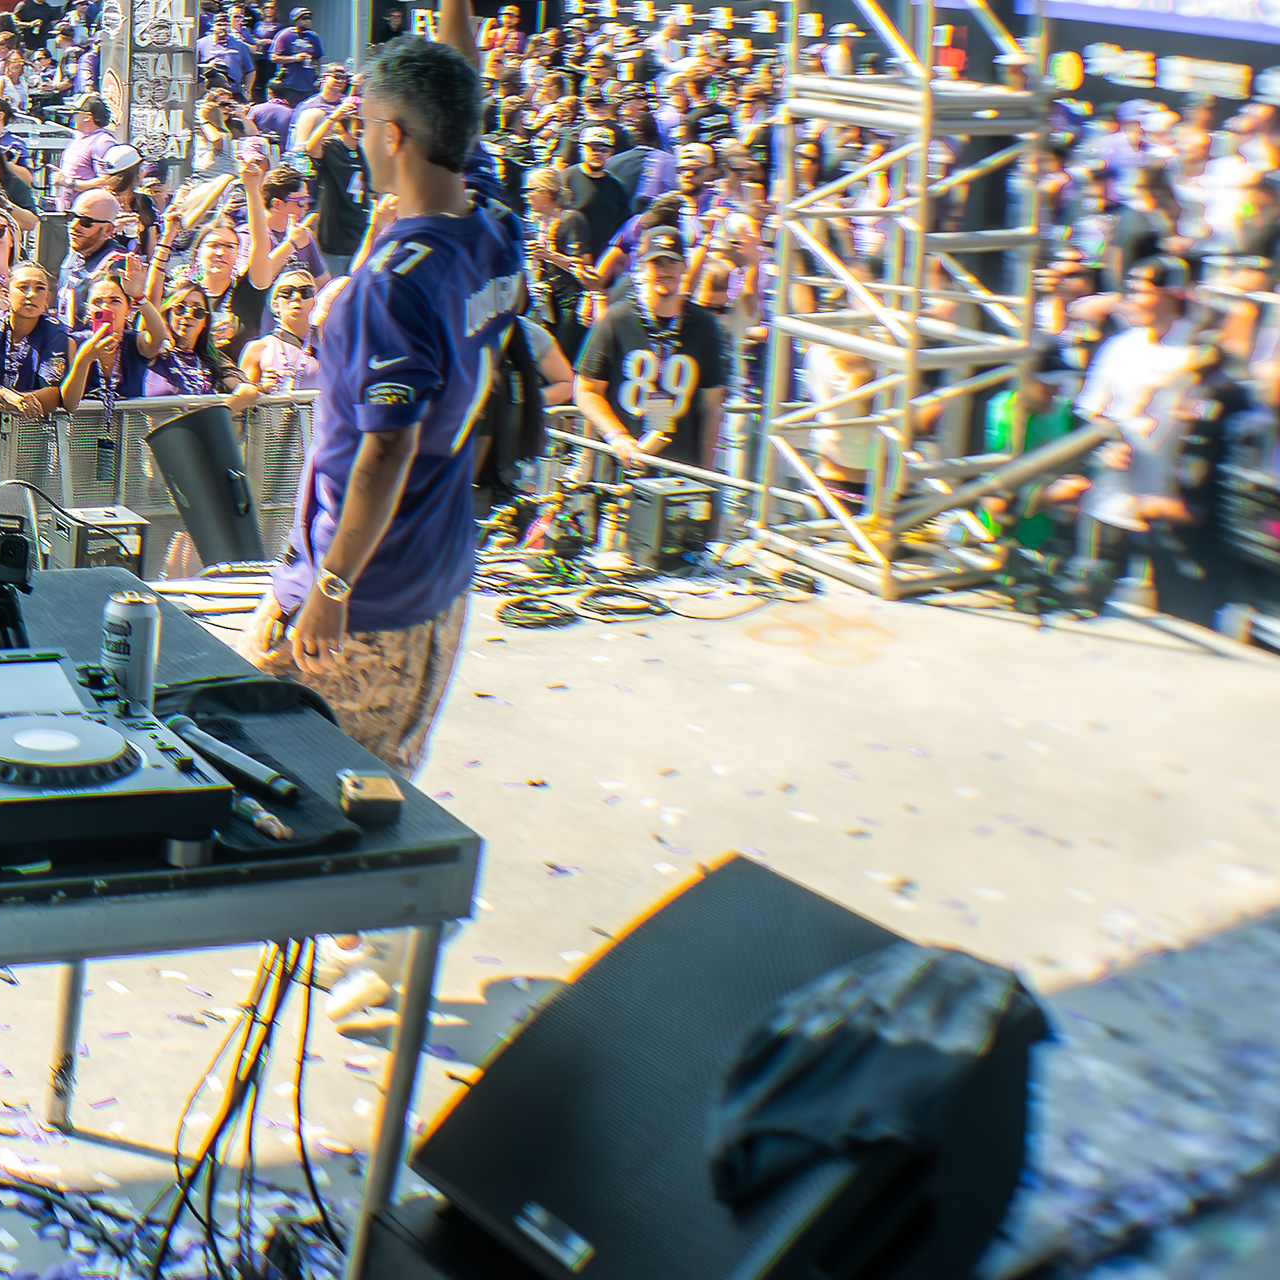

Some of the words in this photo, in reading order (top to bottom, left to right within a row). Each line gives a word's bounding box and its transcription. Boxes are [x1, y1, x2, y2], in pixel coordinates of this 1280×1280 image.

[132, 52, 192, 83] TAIL
[131, 108, 191, 140] TAIL
[618, 348, 699, 420] 89
